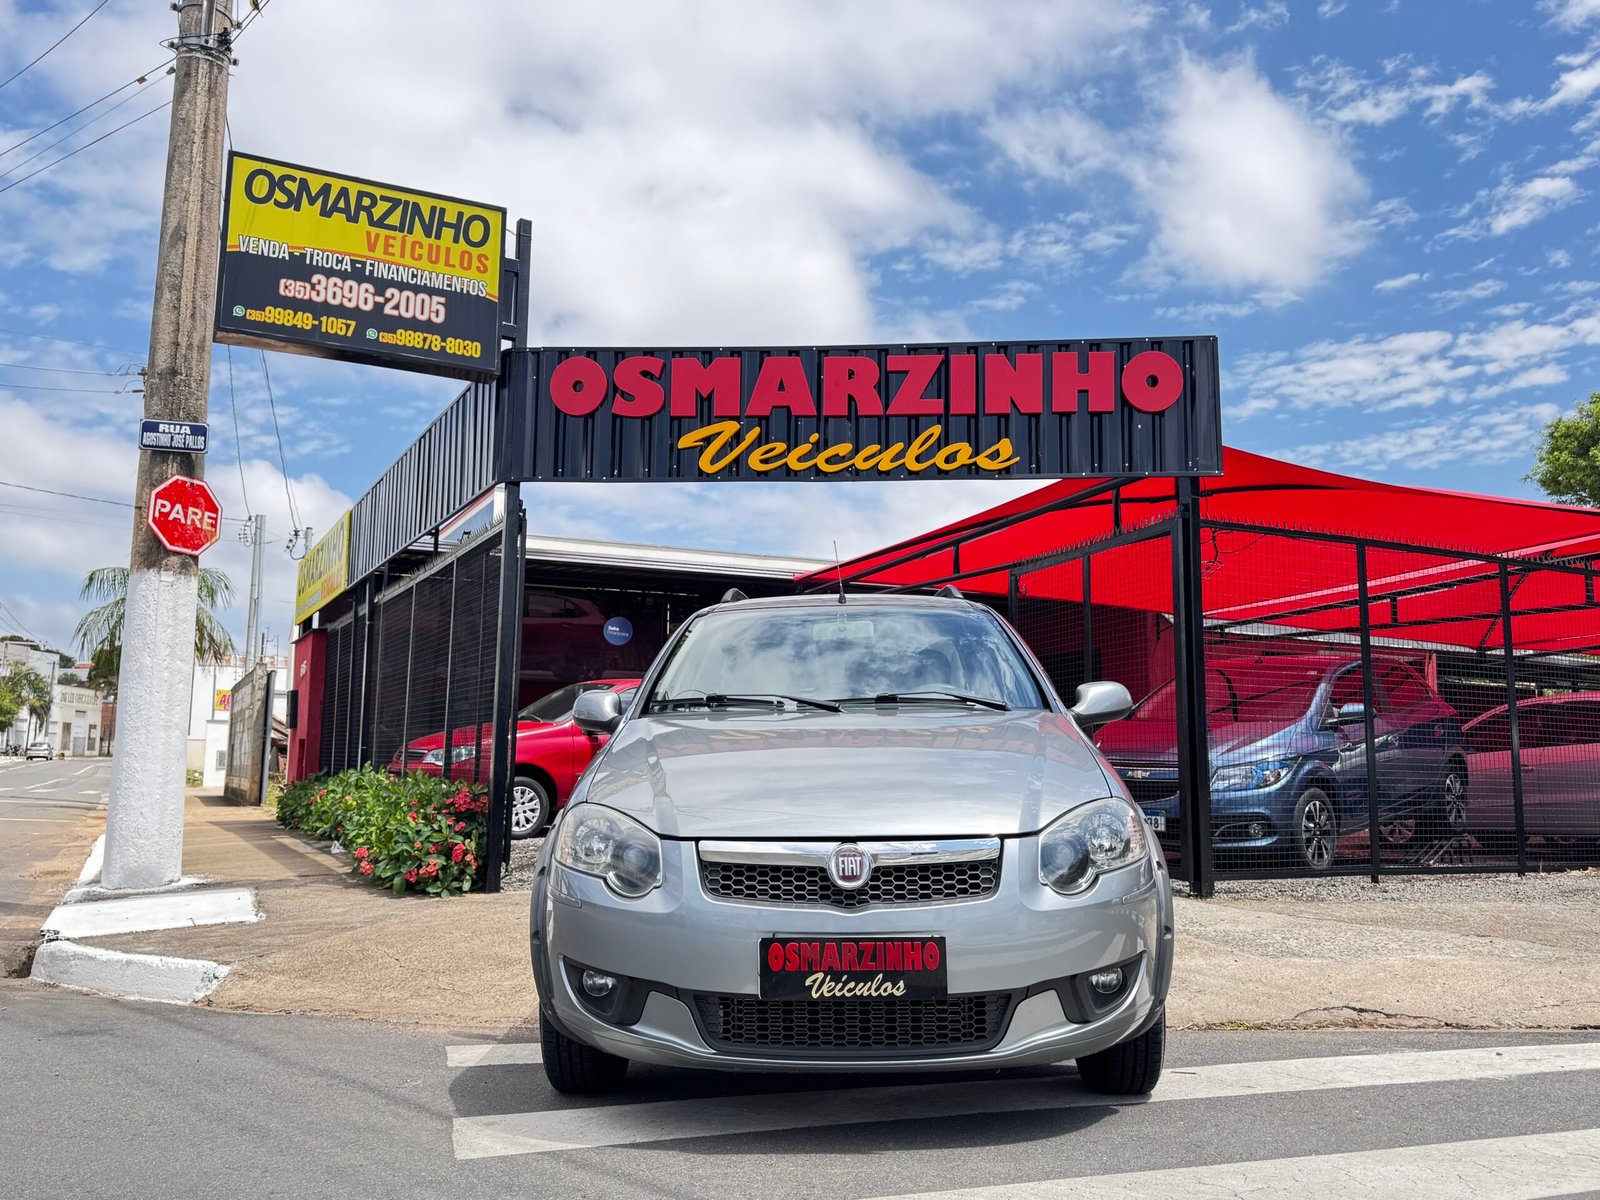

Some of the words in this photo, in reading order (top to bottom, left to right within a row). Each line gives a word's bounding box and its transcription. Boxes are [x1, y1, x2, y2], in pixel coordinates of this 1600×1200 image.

[244, 168, 491, 248] OSMARZINHO
[238, 234, 290, 261] VENDA
[304, 246, 352, 273] TROCA
[365, 259, 488, 297] FINANCIAMENTOS
[365, 230, 490, 274] VEÍCULOS
[550, 350, 1184, 418] OSMARZINHO
[158, 423, 191, 434] RUA
[678, 420, 1020, 475] Veiculos
[154, 499, 216, 532] PARE
[839, 856, 862, 877] FIAT
[768, 942, 940, 972] OSMARZINHO
